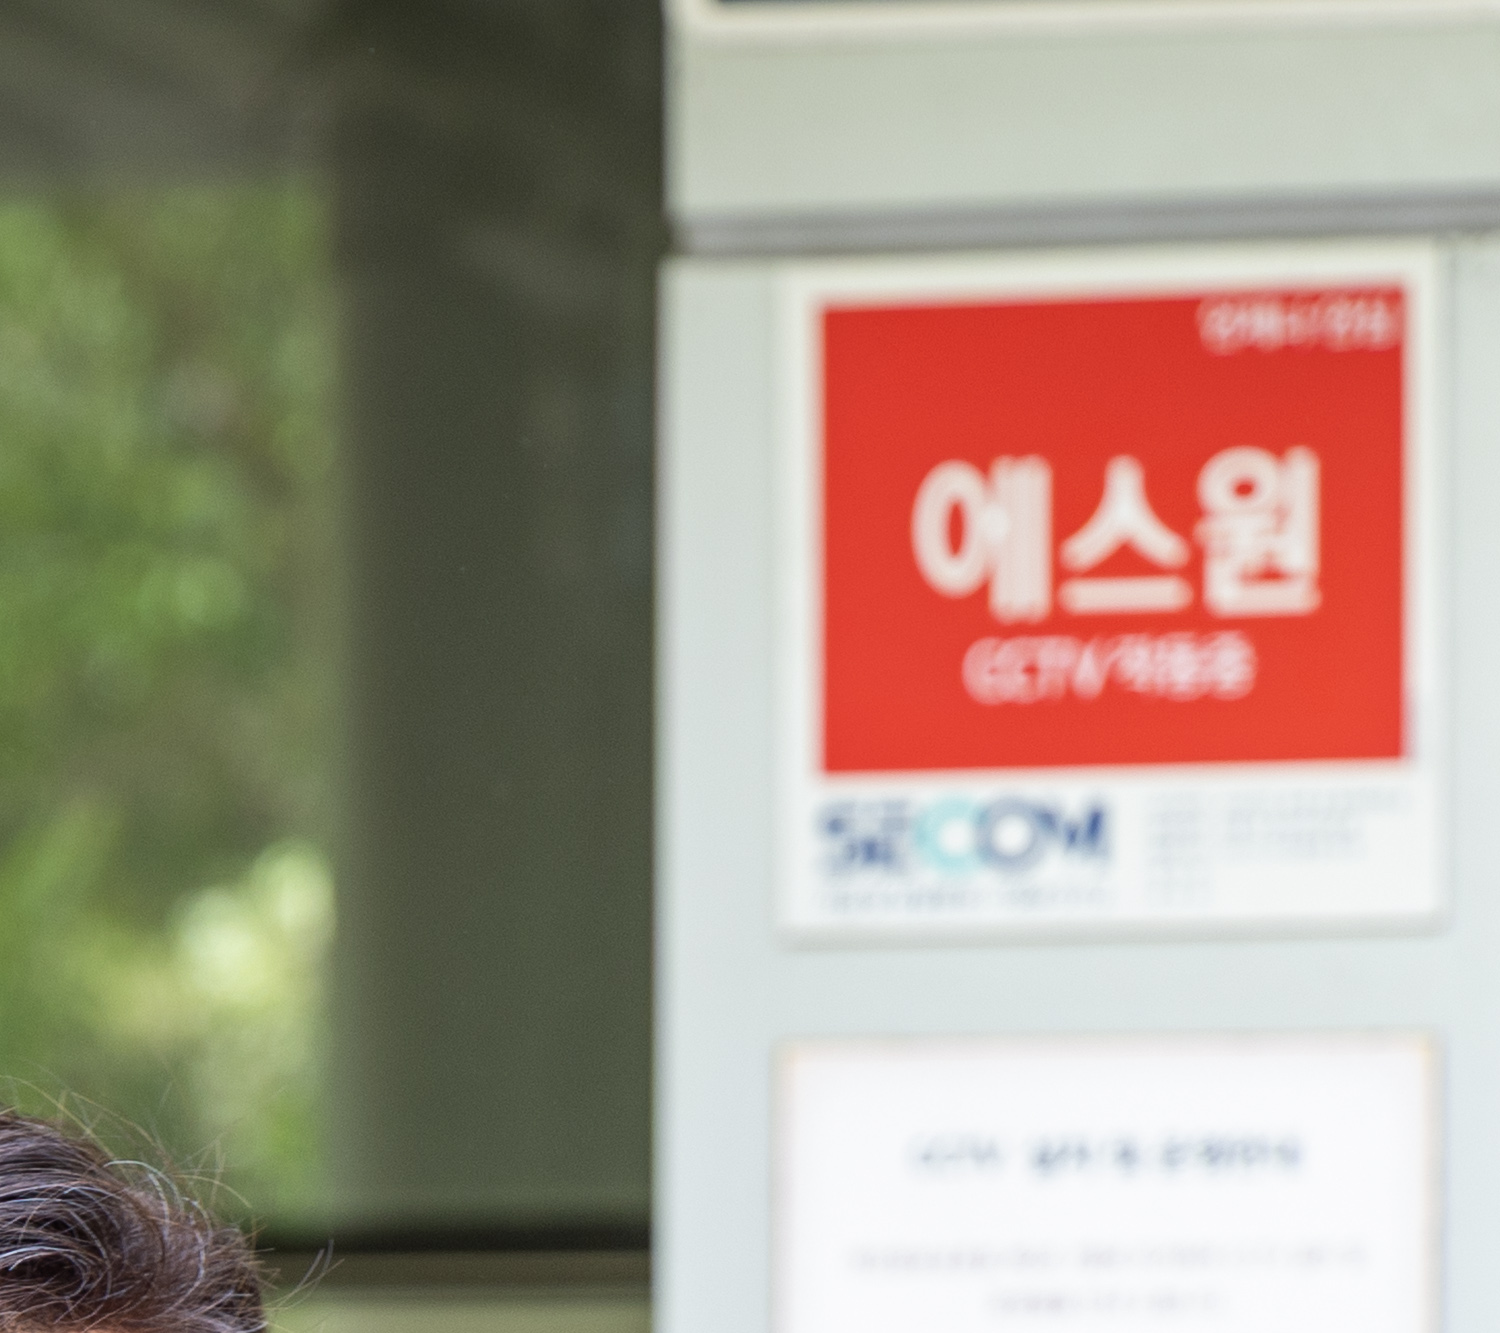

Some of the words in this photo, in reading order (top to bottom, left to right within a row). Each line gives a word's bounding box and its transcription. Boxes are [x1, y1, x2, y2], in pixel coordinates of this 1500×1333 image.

[914, 448, 1319, 620] 에스원
[965, 638, 1106, 702] CCTV
[818, 795, 1111, 875] SECOM
